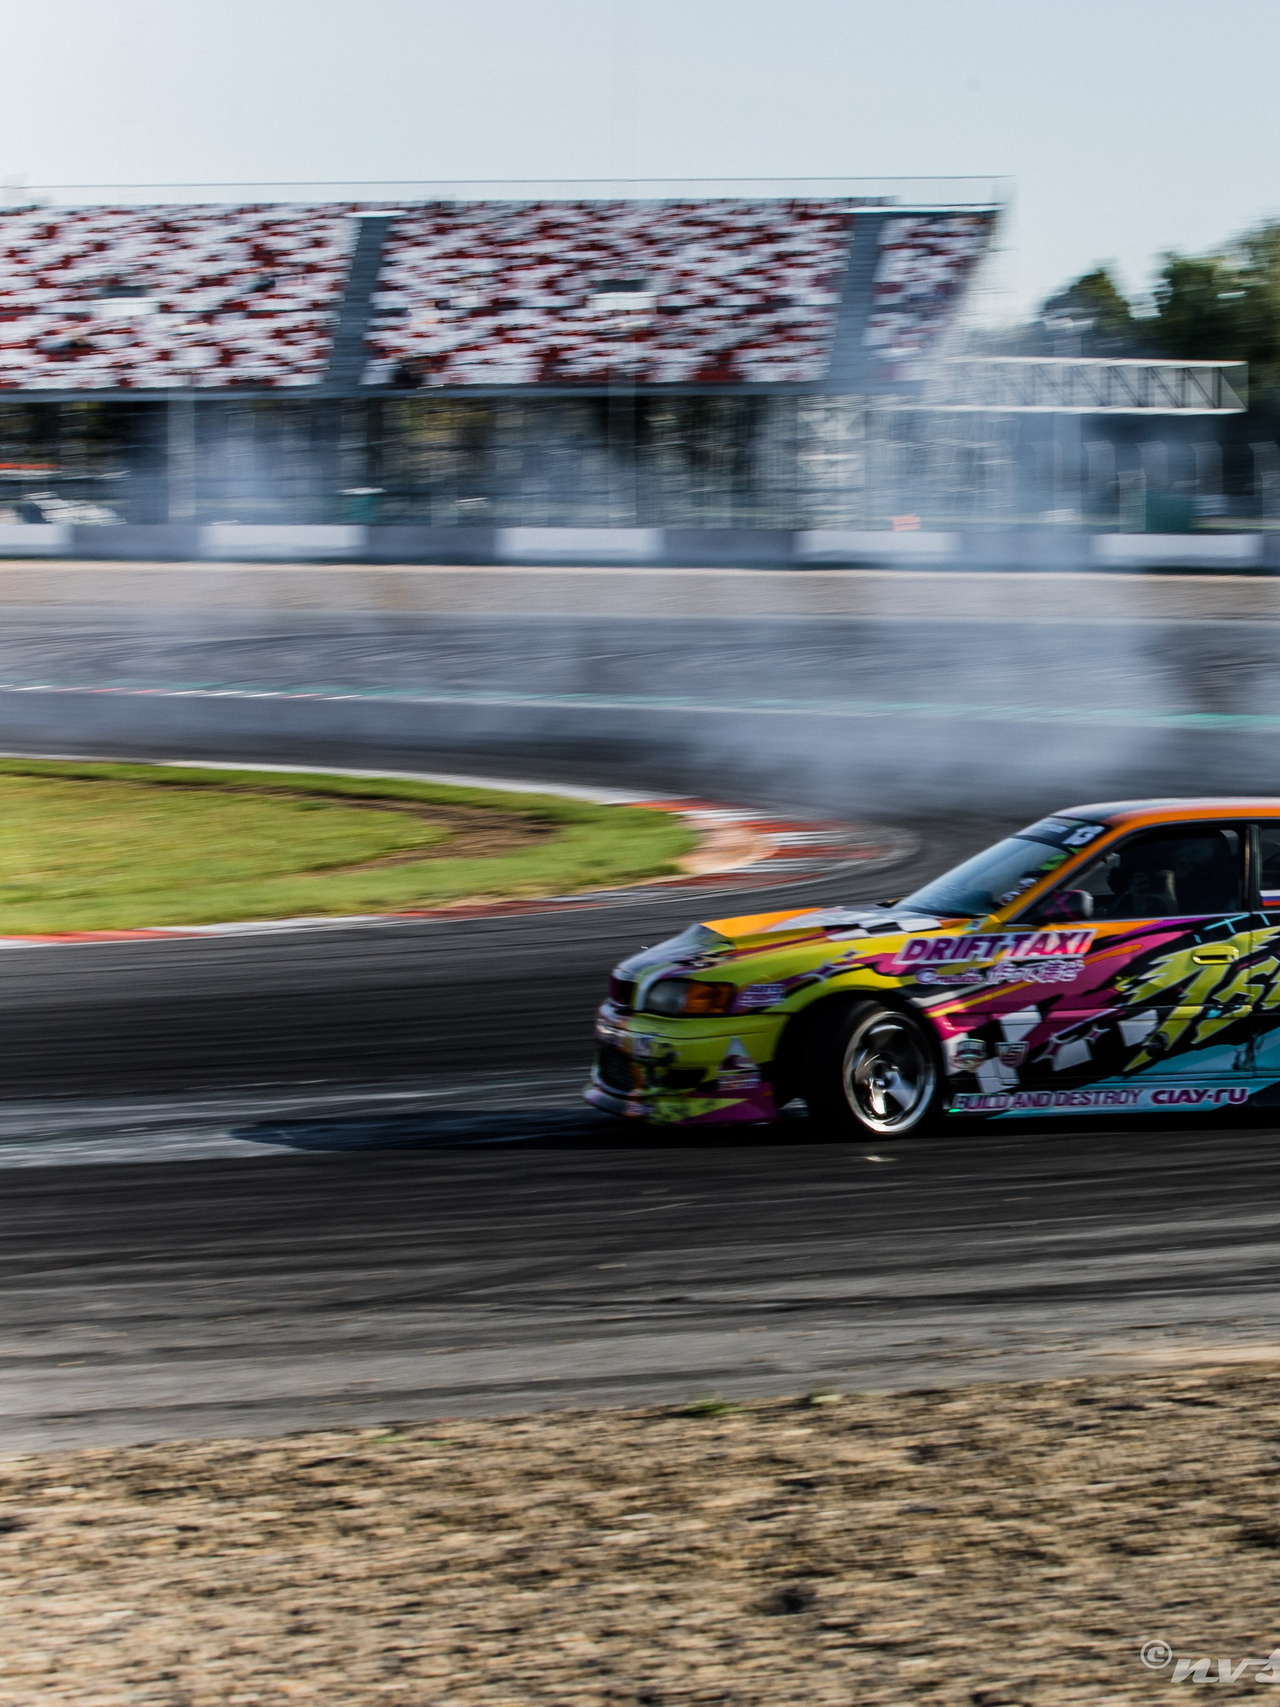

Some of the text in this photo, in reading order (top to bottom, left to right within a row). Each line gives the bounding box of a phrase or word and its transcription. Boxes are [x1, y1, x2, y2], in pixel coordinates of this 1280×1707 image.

[899, 930, 1095, 962] DRIFT TAXI
[955, 1094, 1011, 1111] BUILD
[1012, 1092, 1050, 1109] AND
[1052, 1089, 1143, 1107] DESTROY
